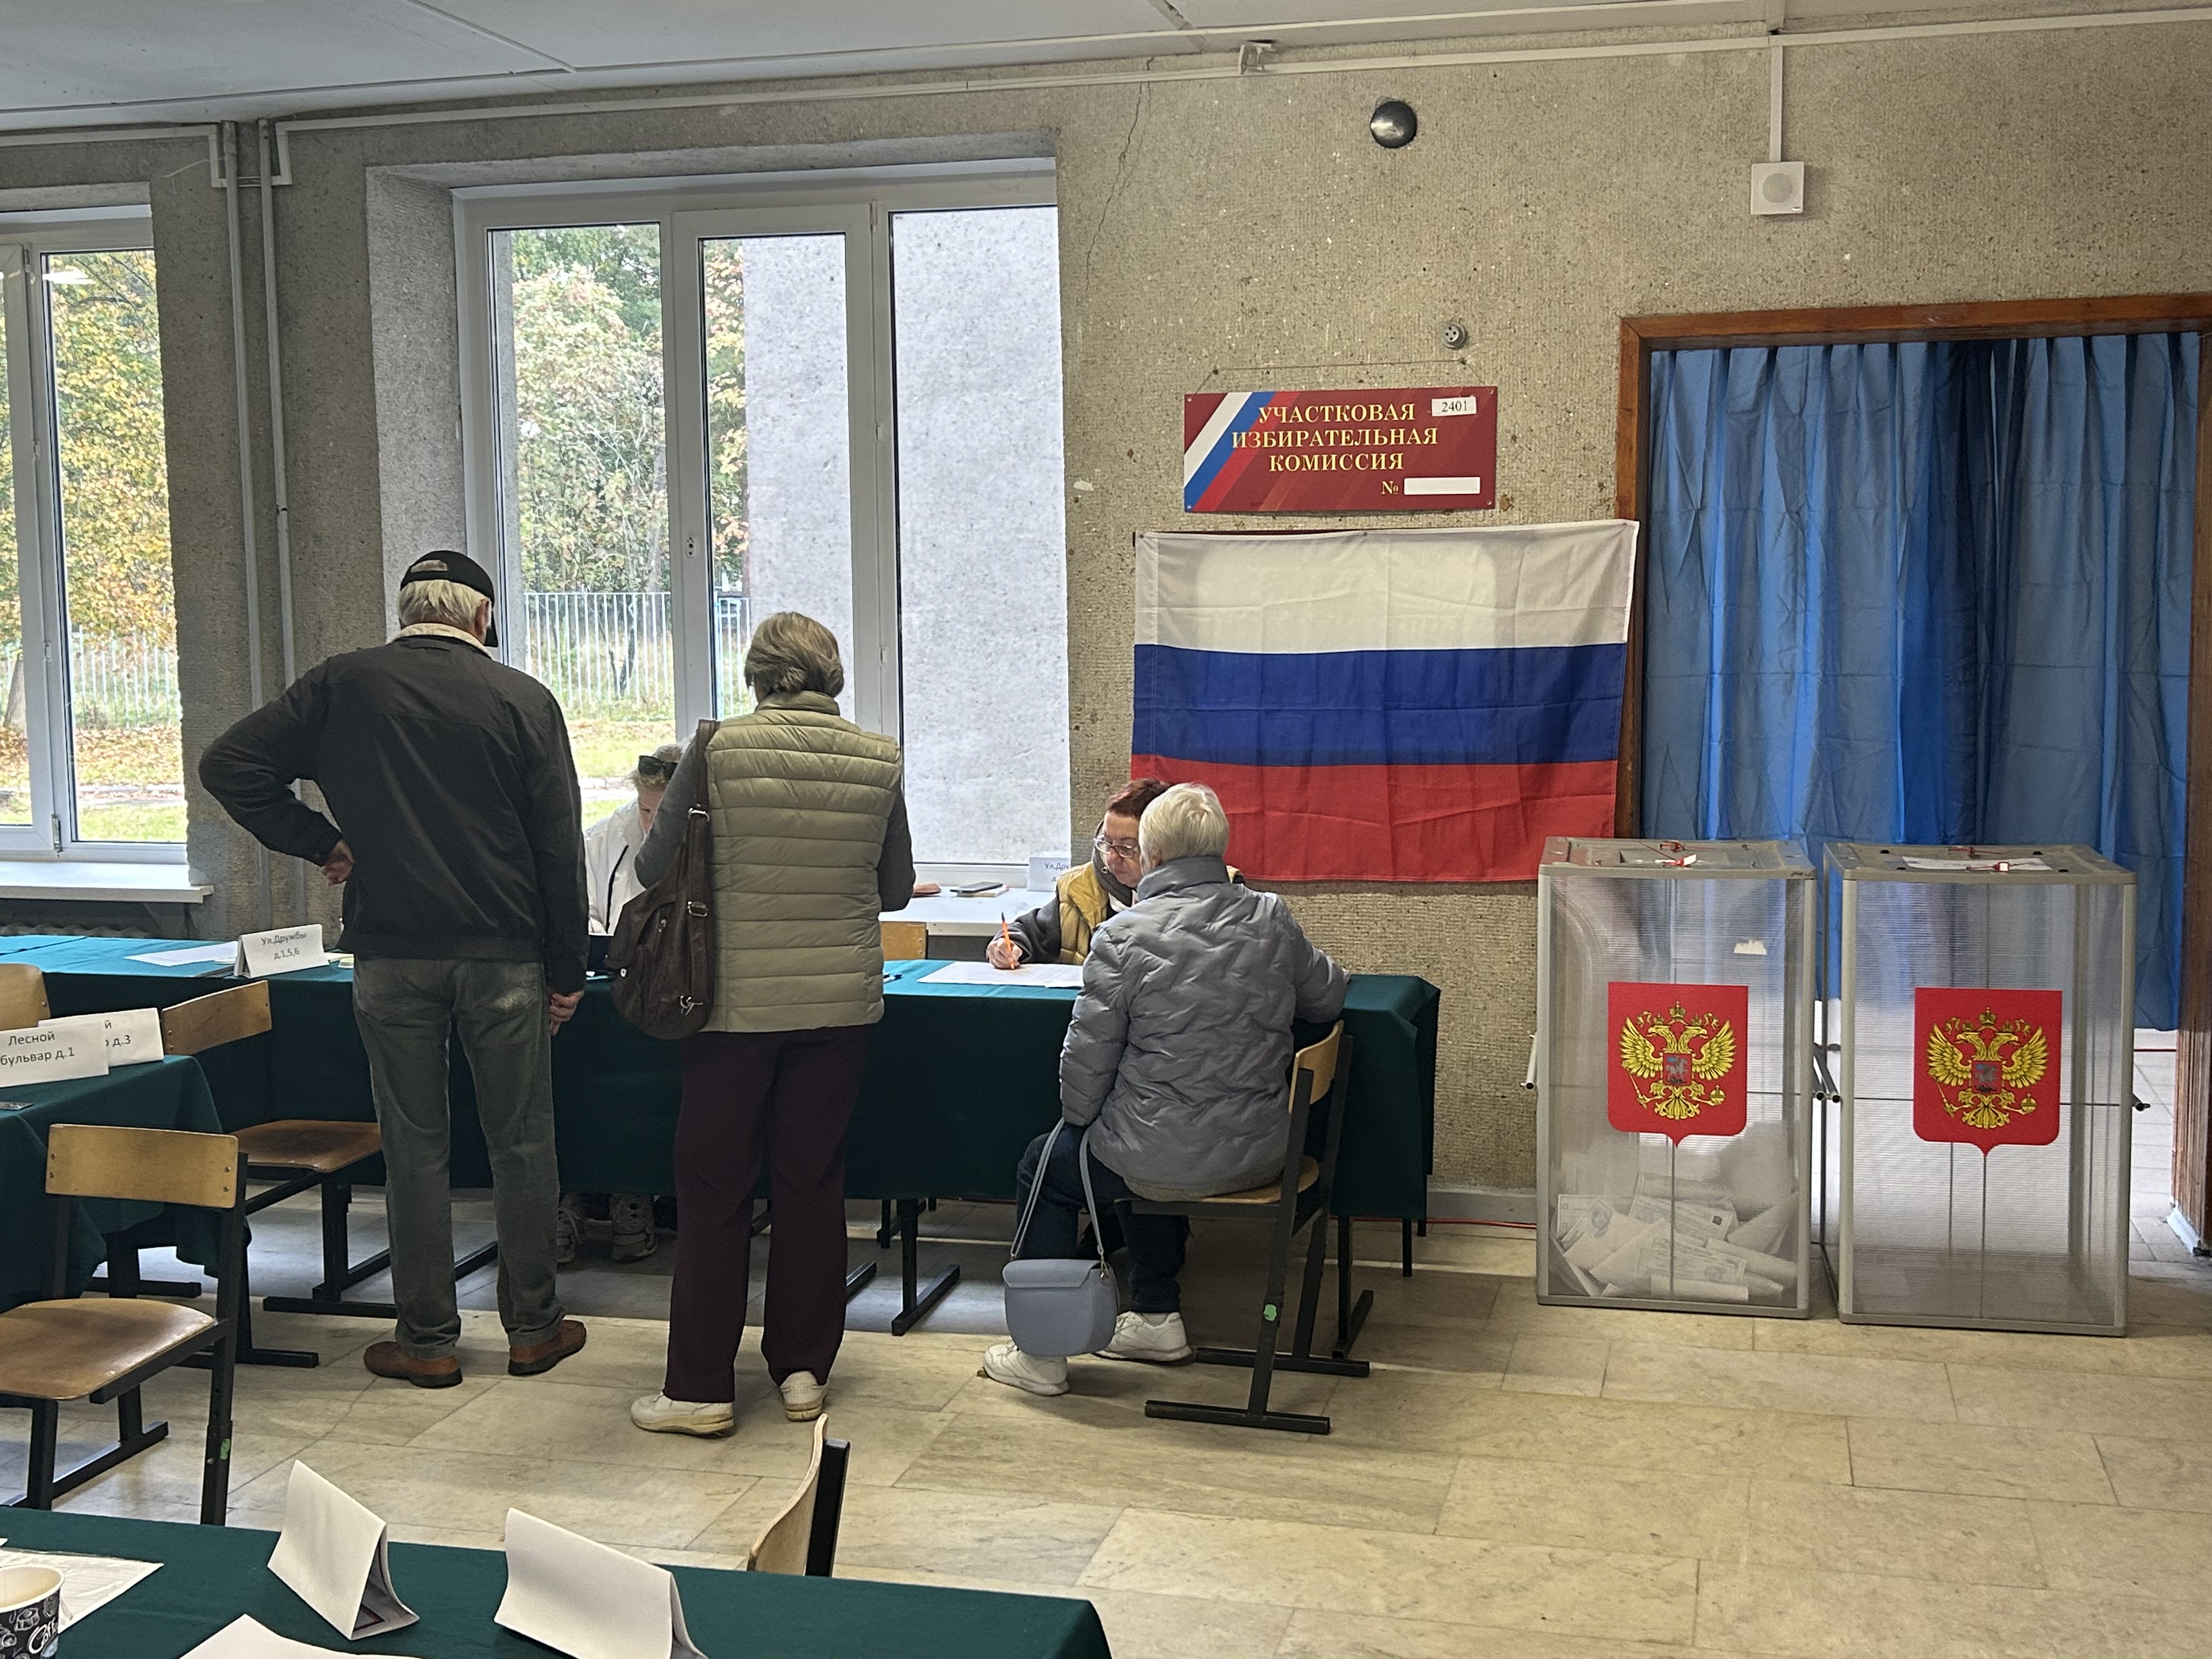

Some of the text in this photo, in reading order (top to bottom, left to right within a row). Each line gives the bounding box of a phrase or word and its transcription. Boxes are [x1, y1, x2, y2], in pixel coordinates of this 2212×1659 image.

[1259, 404, 1415, 424] УЧАСТКОВАЯ
[1441, 400, 1468, 413] 2401
[1232, 428, 1438, 448] ИЗБИРАТЕЛЬНАЯ
[1269, 453, 1404, 472] КОМИССИЯ
[1381, 481, 1399, 495] №
[8, 1031, 55, 1046] Лесной
[0, 1047, 75, 1066] бульвар д.1
